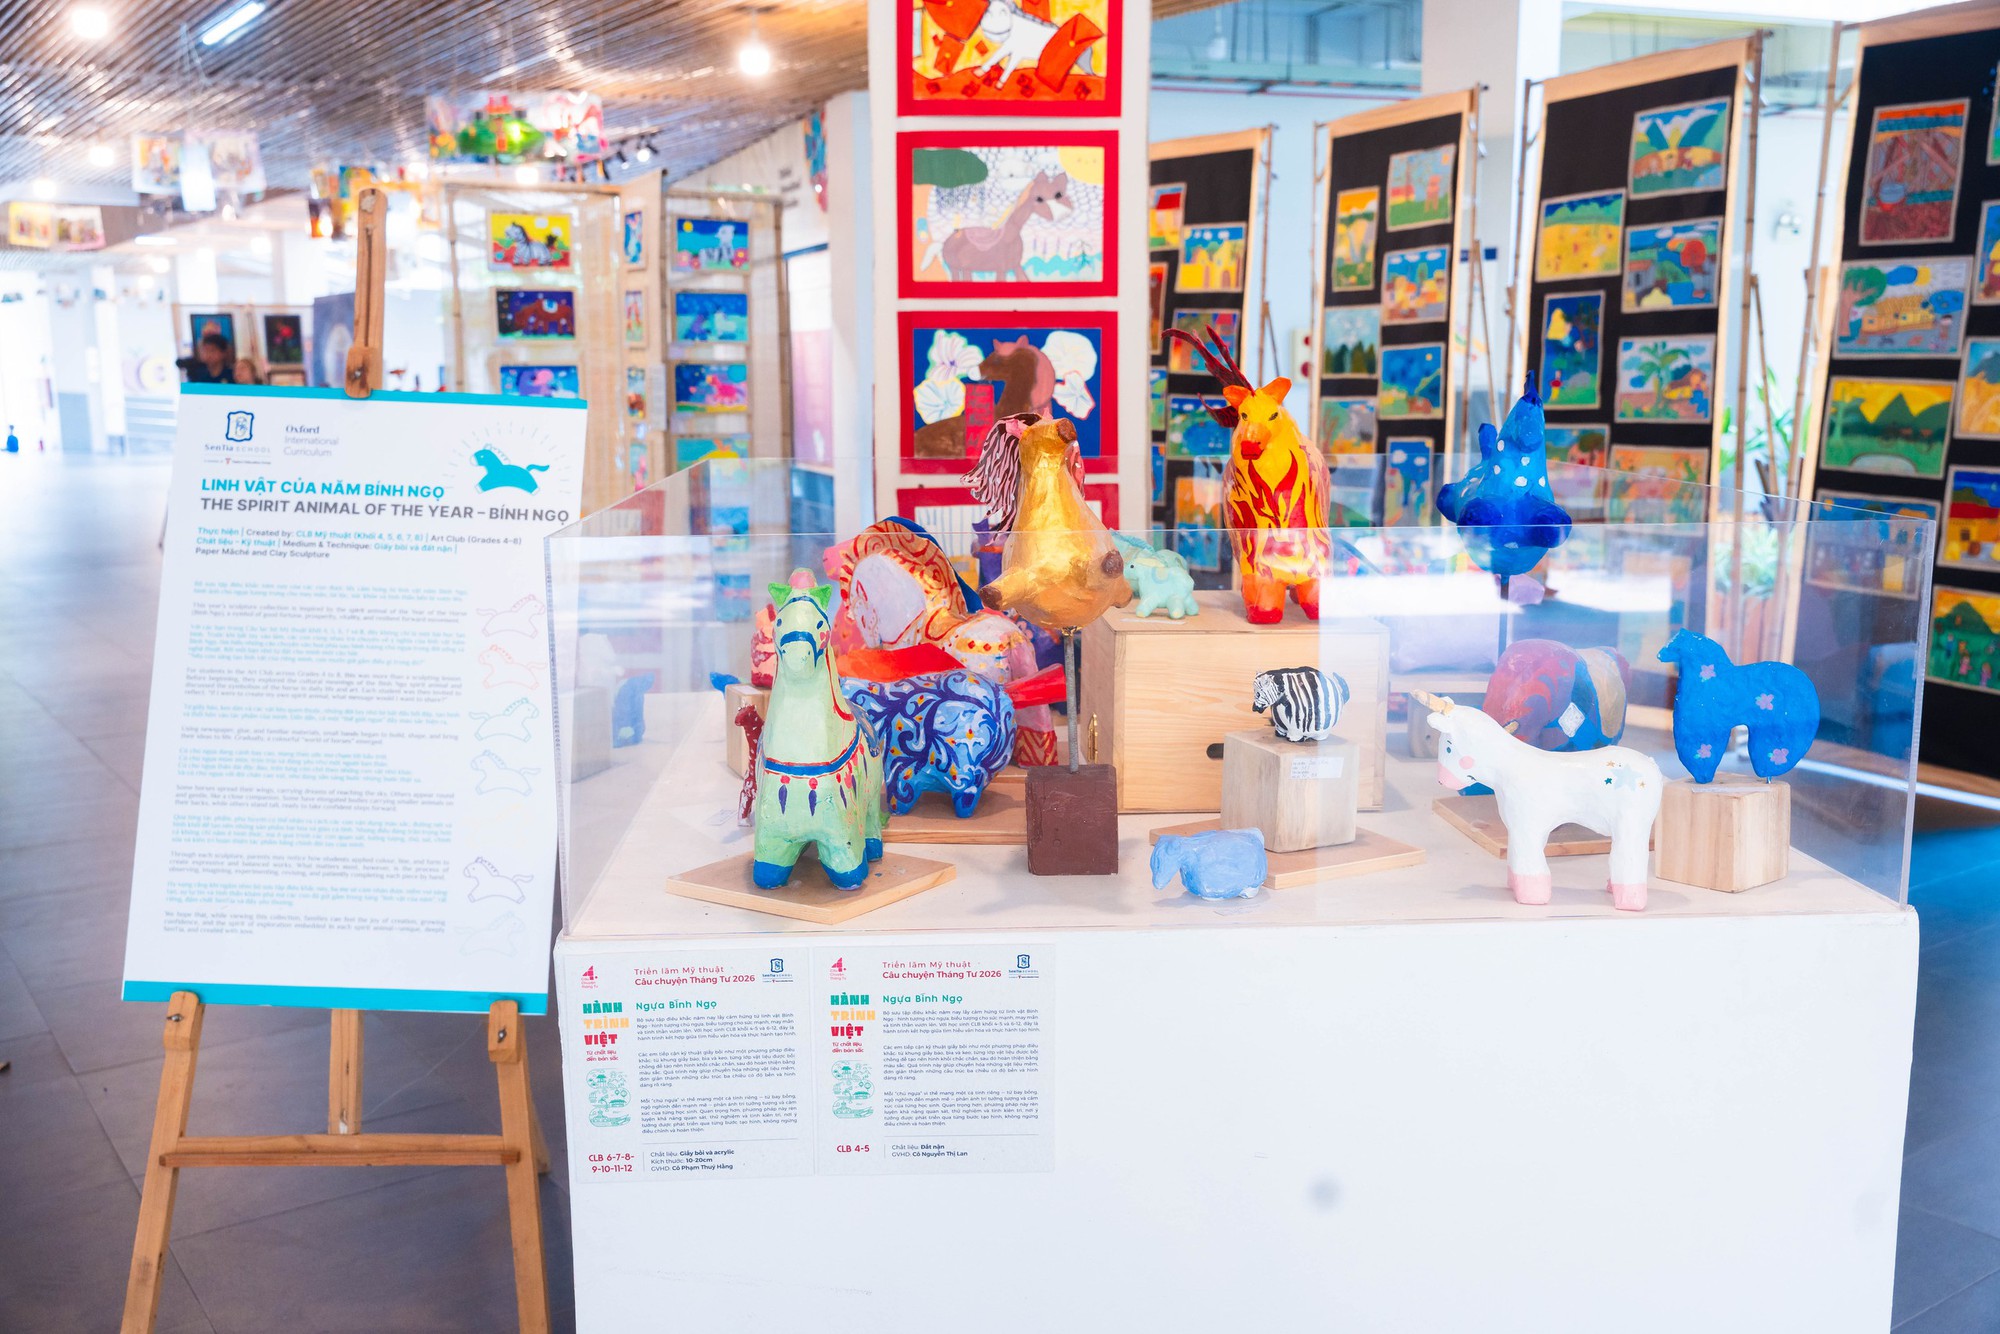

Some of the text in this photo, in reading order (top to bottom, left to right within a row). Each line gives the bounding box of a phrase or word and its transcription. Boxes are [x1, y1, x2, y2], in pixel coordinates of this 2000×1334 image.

[286, 425, 319, 433] Oxford
[285, 436, 339, 445] International
[283, 446, 331, 456] Curriculum
[202, 476, 444, 501] LINH VẬT CỦA NĂM BÍNH NGỌ
[201, 498, 233, 510] THE
[237, 499, 289, 512] SPIRIT
[294, 501, 359, 514] ANIMAL
[365, 504, 386, 515] OF
[391, 504, 423, 516] THE
[429, 506, 473, 518] YEAR
[489, 504, 528, 520] BÍNH
[533, 510, 568, 525] NGỌ
[198, 527, 218, 535] Thực
[315, 530, 327, 539] Mỹ
[468, 536, 501, 544] (Grades
[328, 541, 371, 550] Technique:
[270, 549, 287, 558] Clay
[290, 550, 330, 559] Sculpture
[634, 967, 658, 975] Triển
[683, 967, 695, 975] Mỹ
[699, 966, 724, 974] thuật
[930, 961, 942, 969] Mỹ
[946, 961, 970, 969] thuật
[654, 977, 688, 986] chuyện
[690, 974, 718, 985] Tháng
[902, 971, 934, 980] chuyện
[937, 968, 964, 980] Tháng
[830, 992, 869, 1005] HÀNH
[883, 995, 911, 1005] Ngựa
[942, 995, 962, 1004] Ngọ
[583, 1000, 622, 1014] HÀNH
[636, 1002, 665, 1012] Ngựa
[696, 1000, 717, 1010] Ngọ
[831, 1008, 875, 1021] TRÌNH
[584, 1016, 629, 1029] TRÌNH
[831, 1023, 863, 1039] VIỆT
[584, 1031, 617, 1047] VIỆT
[588, 1153, 634, 1162] CLB 6-7-8-
[592, 1164, 632, 1173] 9-10-11-12
